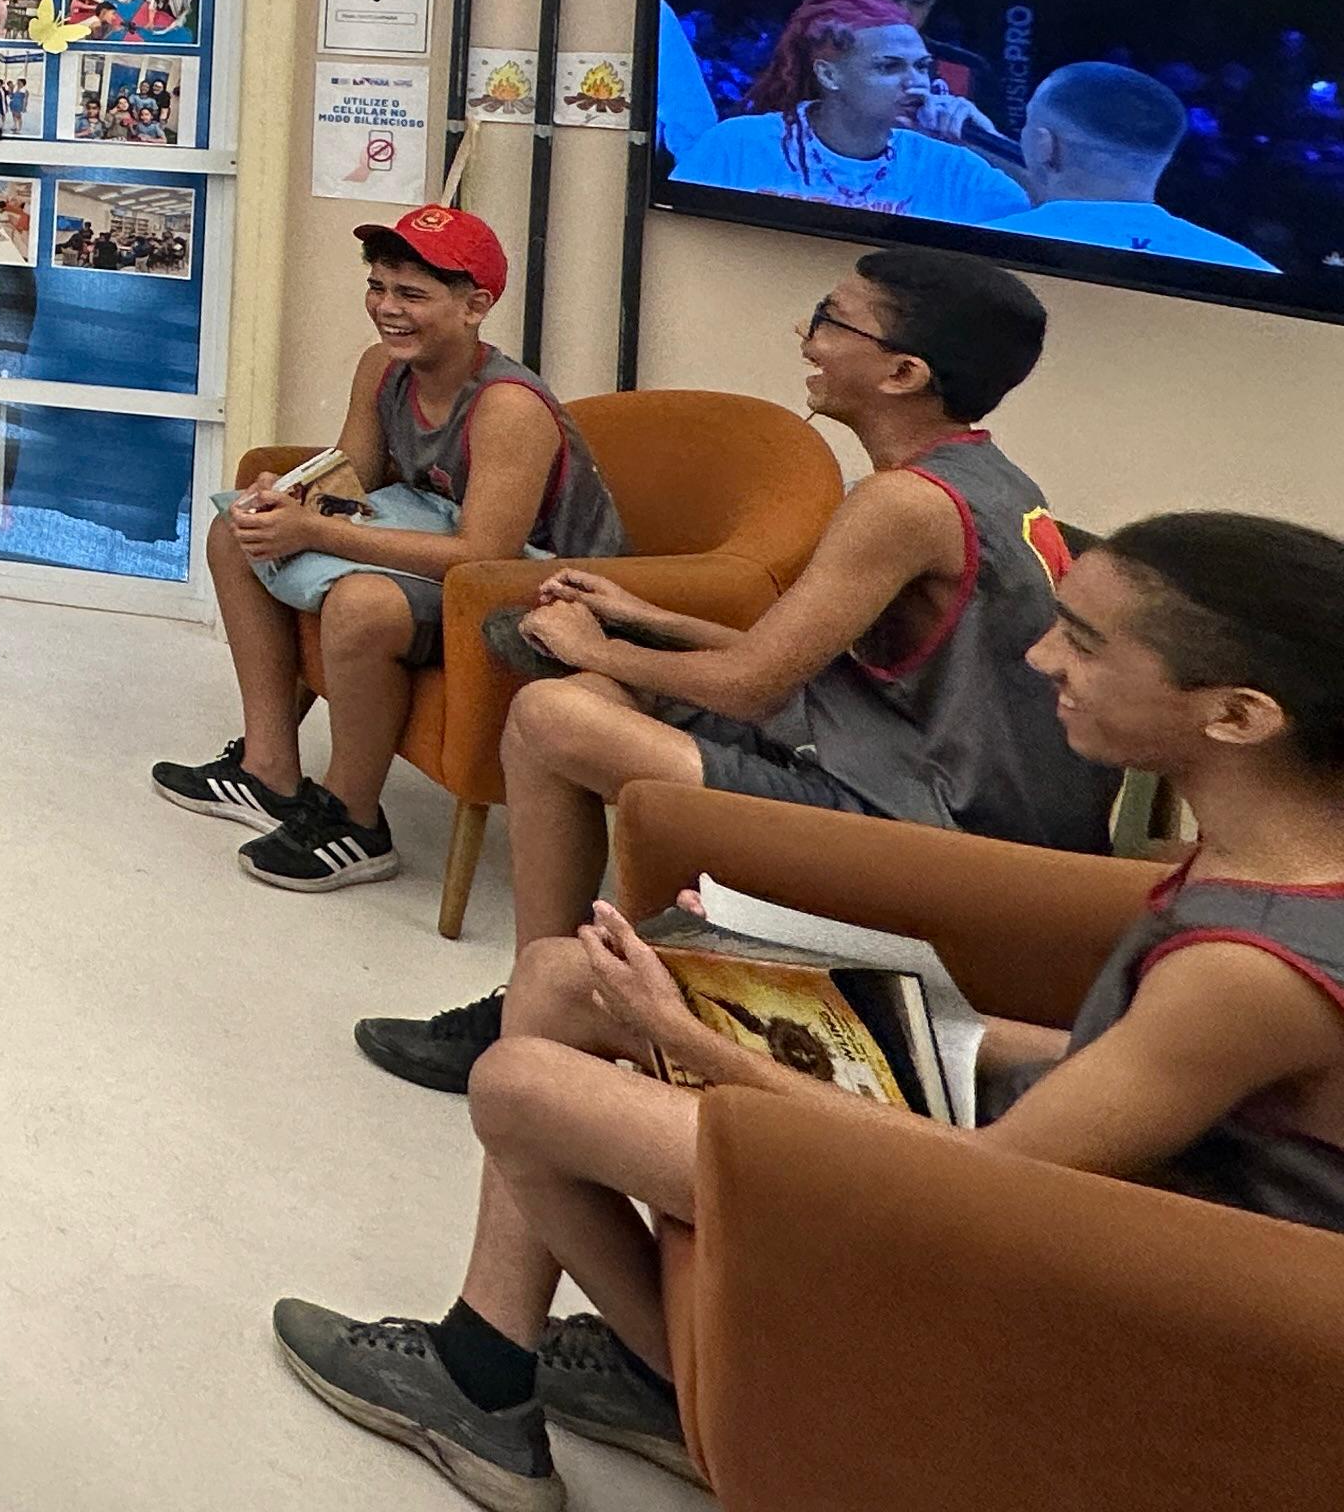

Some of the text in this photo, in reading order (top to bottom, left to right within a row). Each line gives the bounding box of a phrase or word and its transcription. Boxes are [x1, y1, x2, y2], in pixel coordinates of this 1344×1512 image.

[343, 96, 400, 108] UTILIZE O
[332, 105, 407, 118] CELULAR NO
[318, 113, 351, 124] MODO
